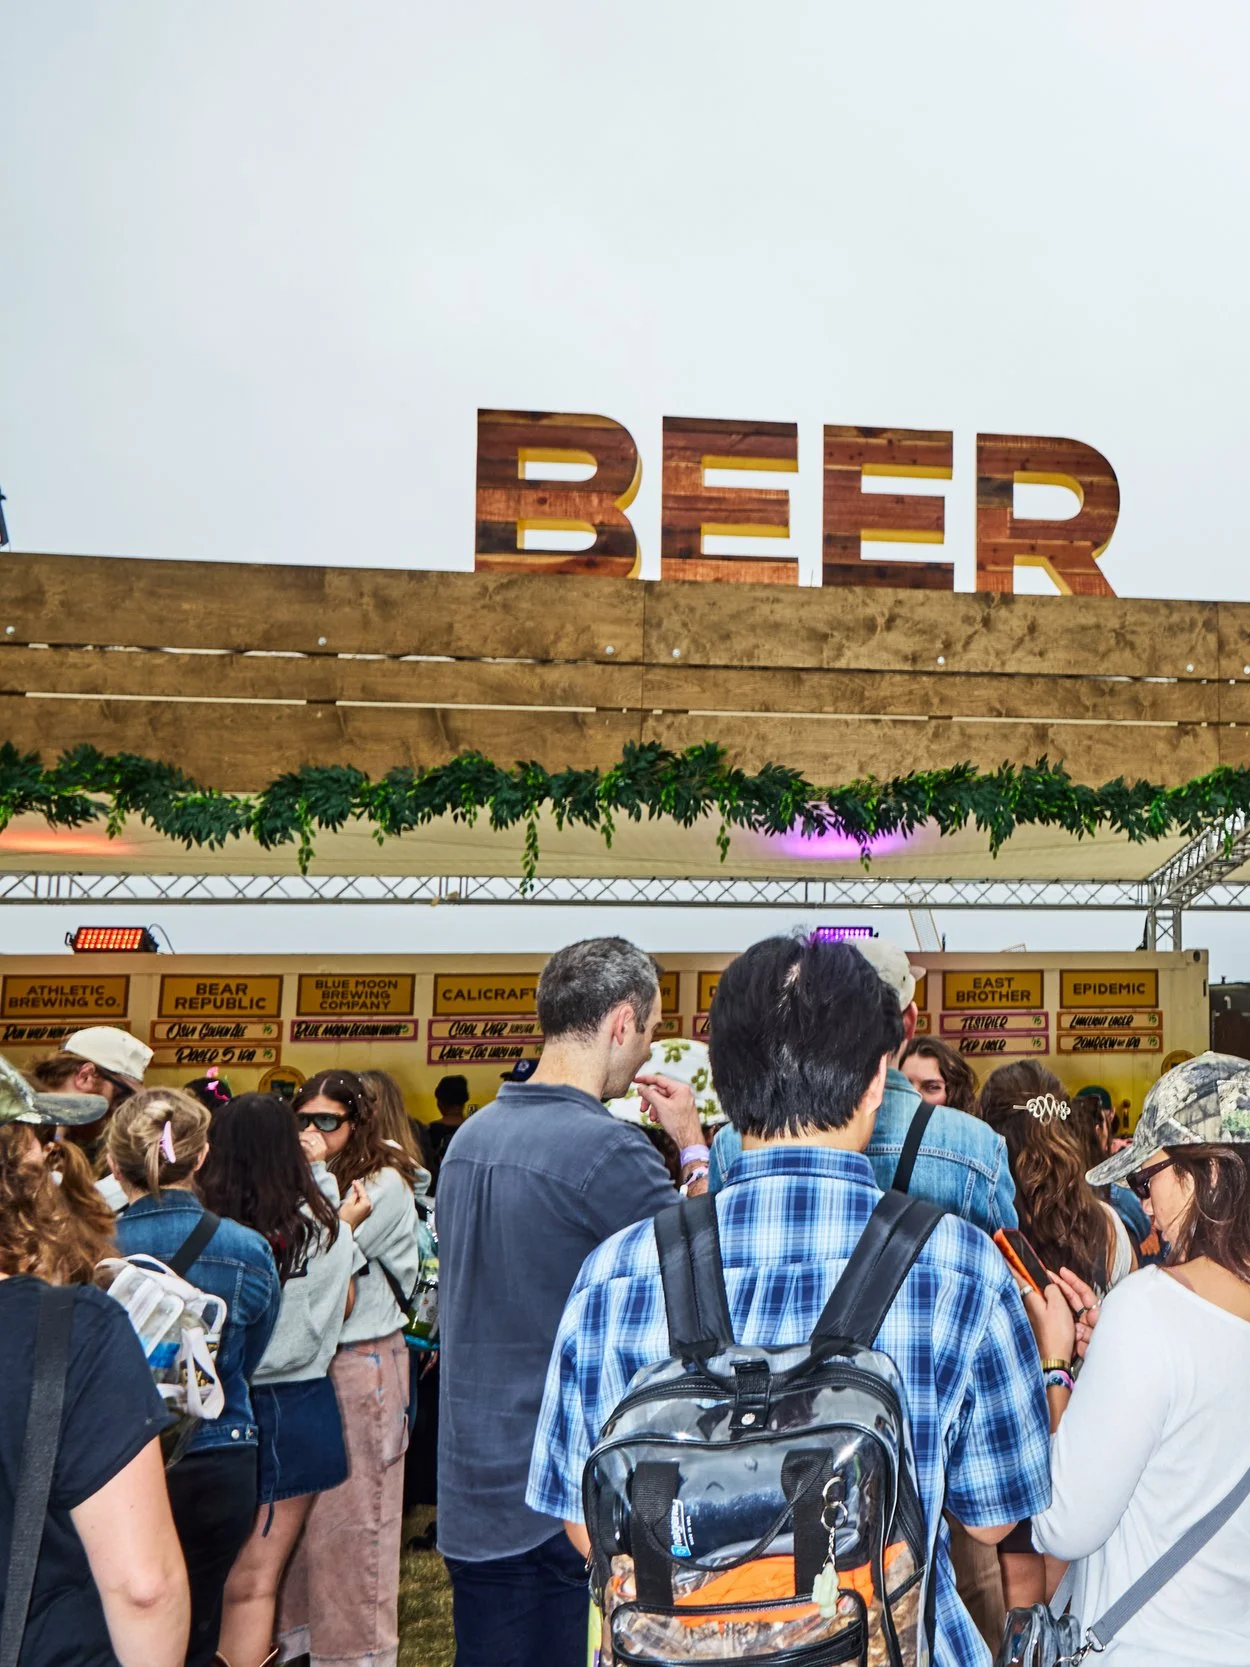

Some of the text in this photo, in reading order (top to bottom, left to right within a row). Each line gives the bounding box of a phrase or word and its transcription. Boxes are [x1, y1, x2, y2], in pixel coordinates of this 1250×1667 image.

[475, 408, 1120, 599] BEER
[315, 980, 398, 990] BLUE MOON
[973, 977, 1014, 989] EAST
[1073, 983, 1146, 995] EPIDEMIC
[27, 984, 105, 996] ATHLETIC
[196, 983, 249, 996] BEAR
[321, 990, 391, 1000] BREWING
[956, 990, 1031, 1002] BROTHER
[8, 996, 121, 1009] BREWING CO.
[174, 997, 266, 1010] REPUBLIC
[319, 1001, 391, 1010] COMPANY
